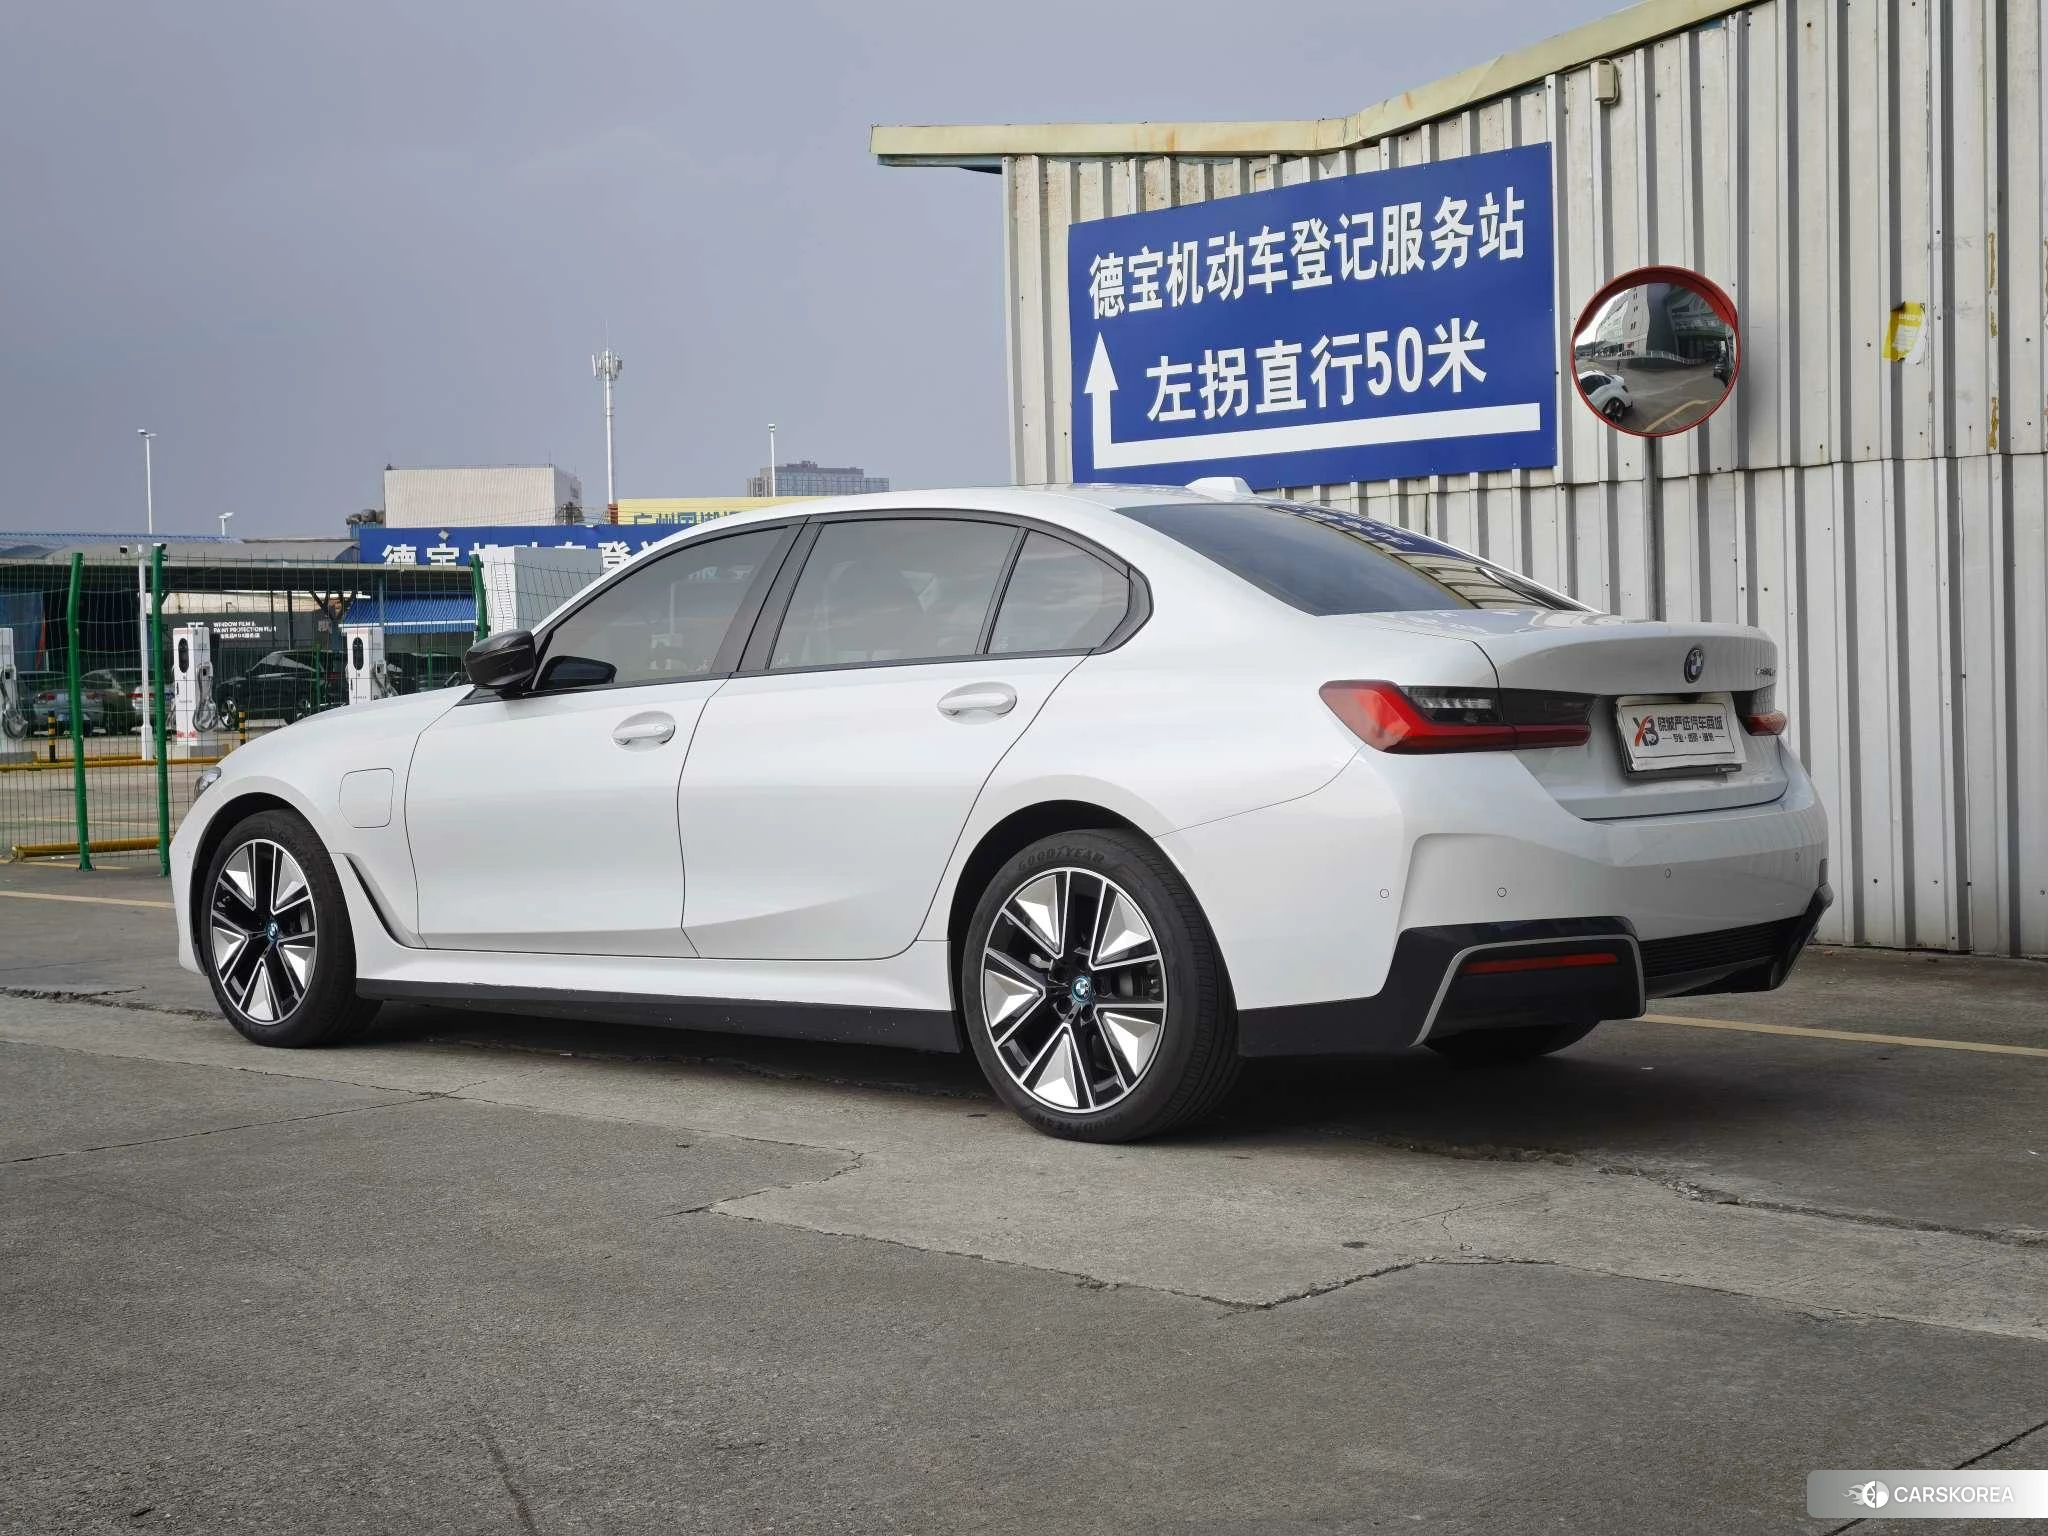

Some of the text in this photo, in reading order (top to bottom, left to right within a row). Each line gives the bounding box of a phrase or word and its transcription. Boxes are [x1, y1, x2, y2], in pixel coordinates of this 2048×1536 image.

[1089, 187, 1525, 319] 德宝机动车登记服务站
[1146, 317, 1487, 422] 左拐直行50米
[1017, 847, 1105, 871] GOODYEAR
